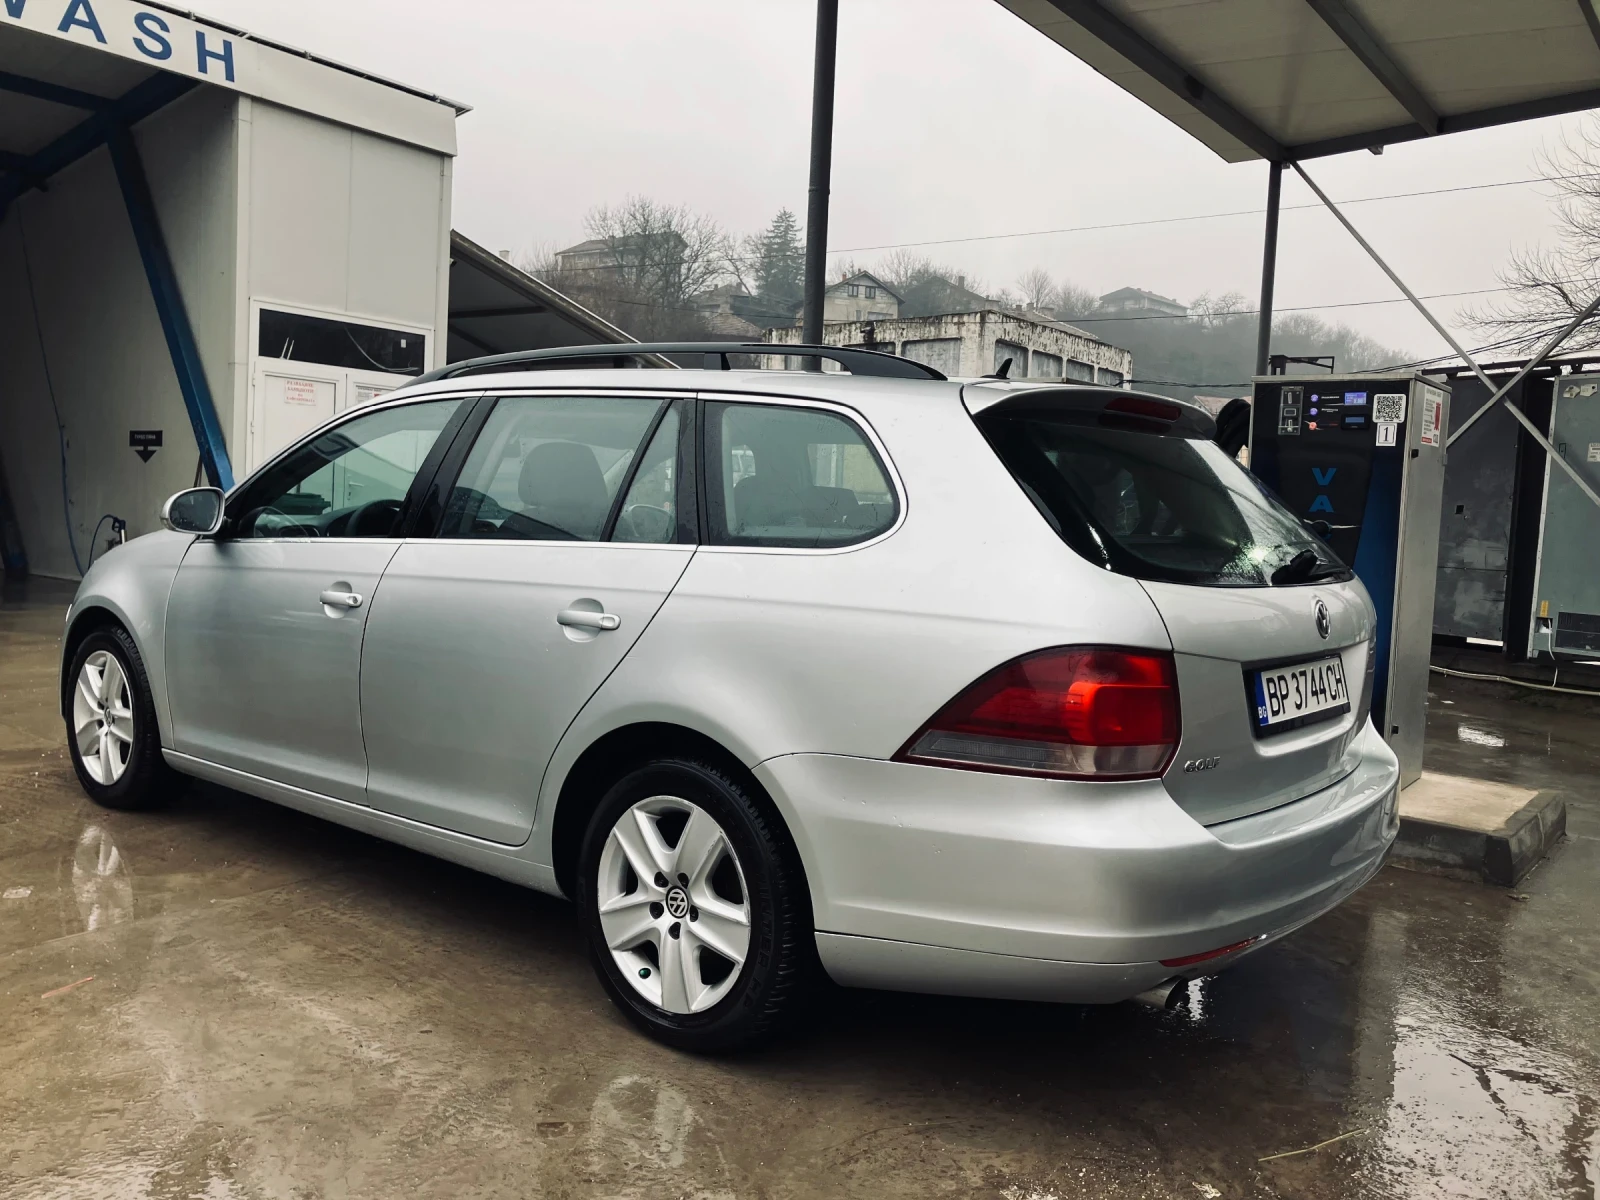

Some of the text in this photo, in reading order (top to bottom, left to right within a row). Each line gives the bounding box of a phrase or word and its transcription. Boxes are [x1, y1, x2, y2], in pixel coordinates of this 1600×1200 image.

[0, 0, 235, 83] ASH
[1383, 426, 1389, 442] 1
[1258, 706, 1268, 719] BG
[1183, 756, 1221, 774] GOLF
